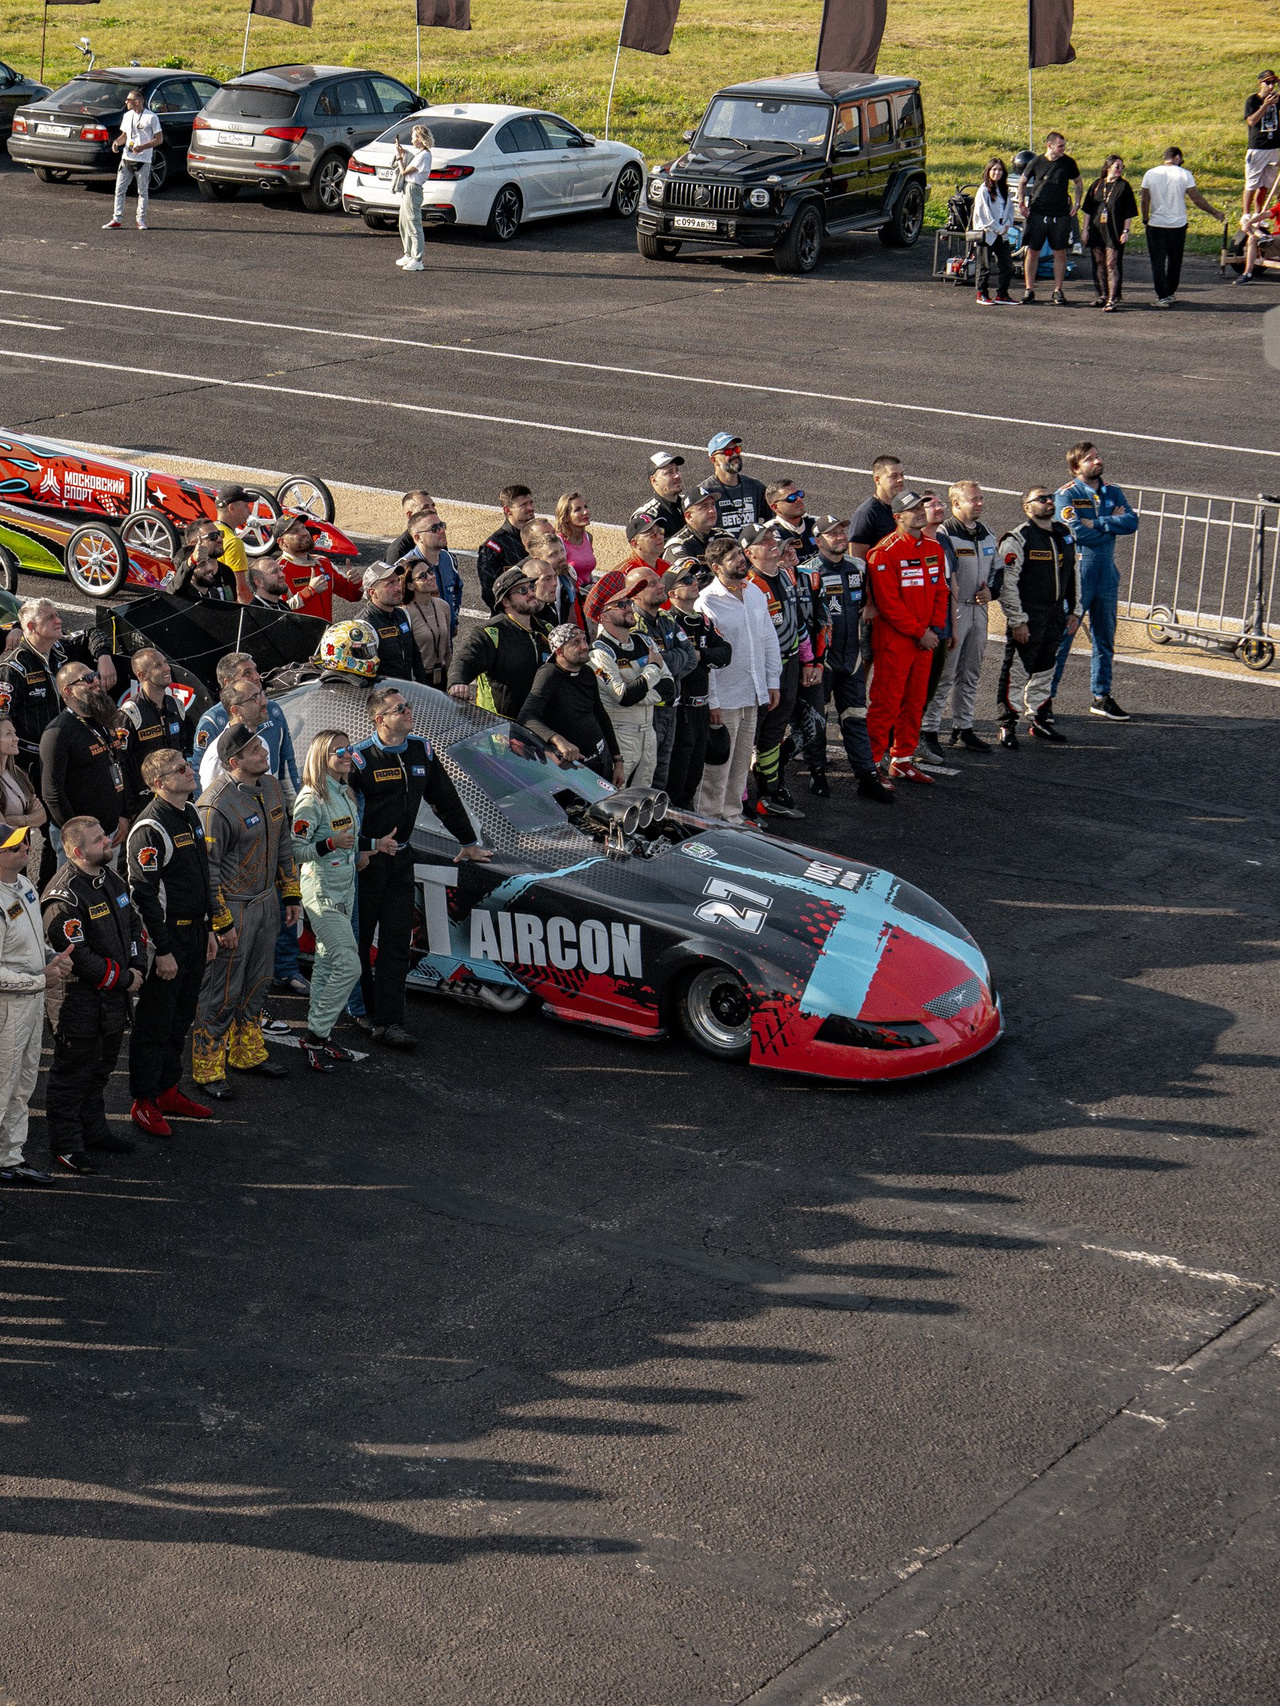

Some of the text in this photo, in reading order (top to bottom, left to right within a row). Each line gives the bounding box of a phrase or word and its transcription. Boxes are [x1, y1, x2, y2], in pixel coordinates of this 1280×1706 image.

[63, 470, 126, 495] МОСКОВСКИЙ
[63, 486, 93, 503] СПОРТ
[693, 876, 775, 935] 27
[470, 908, 643, 980] AIRCON
